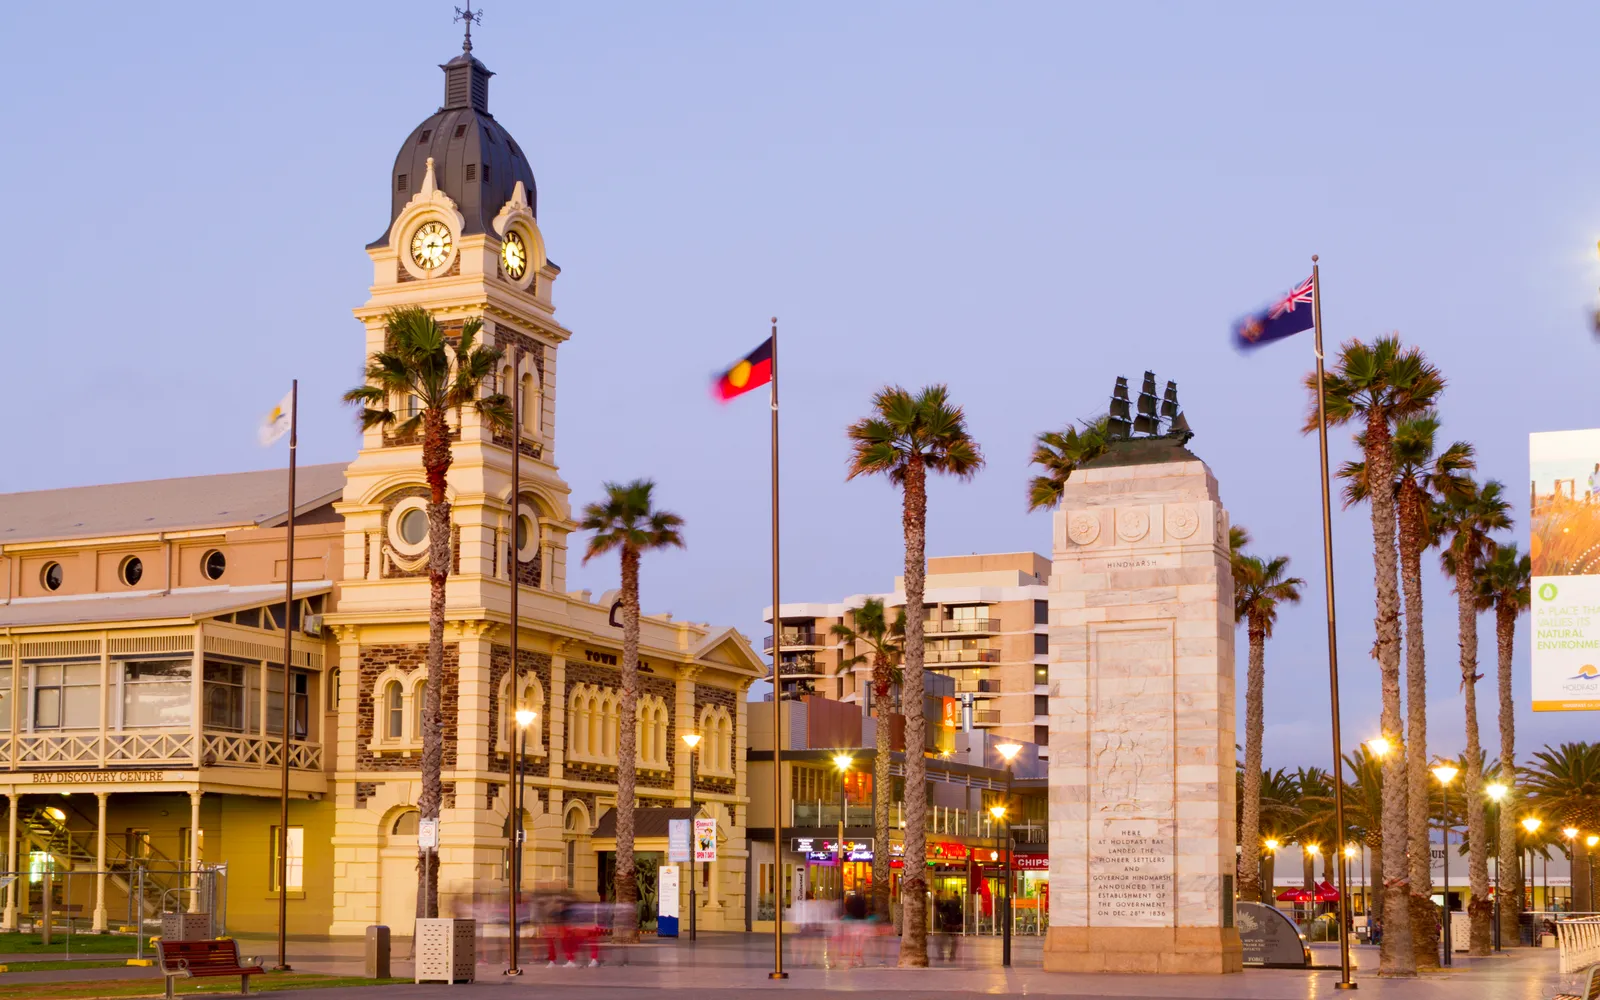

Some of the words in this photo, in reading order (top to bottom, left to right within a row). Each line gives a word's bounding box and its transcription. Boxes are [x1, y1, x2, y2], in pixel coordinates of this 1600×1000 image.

[1107, 560, 1157, 568] HINDMARSH
[1537, 607, 1545, 615] A
[1548, 606, 1578, 616] PLACE
[1537, 617, 1574, 627] VALUES
[1576, 617, 1591, 627] ITS
[1537, 629, 1584, 639] NATURAL
[585, 649, 617, 666] TOWN
[1562, 683, 1598, 691] HOLDFAST
[33, 773, 53, 783] BAY
[56, 772, 116, 783] DISCOVERY
[119, 771, 164, 782] CENTRE
[1018, 858, 1049, 867] CHIPS
